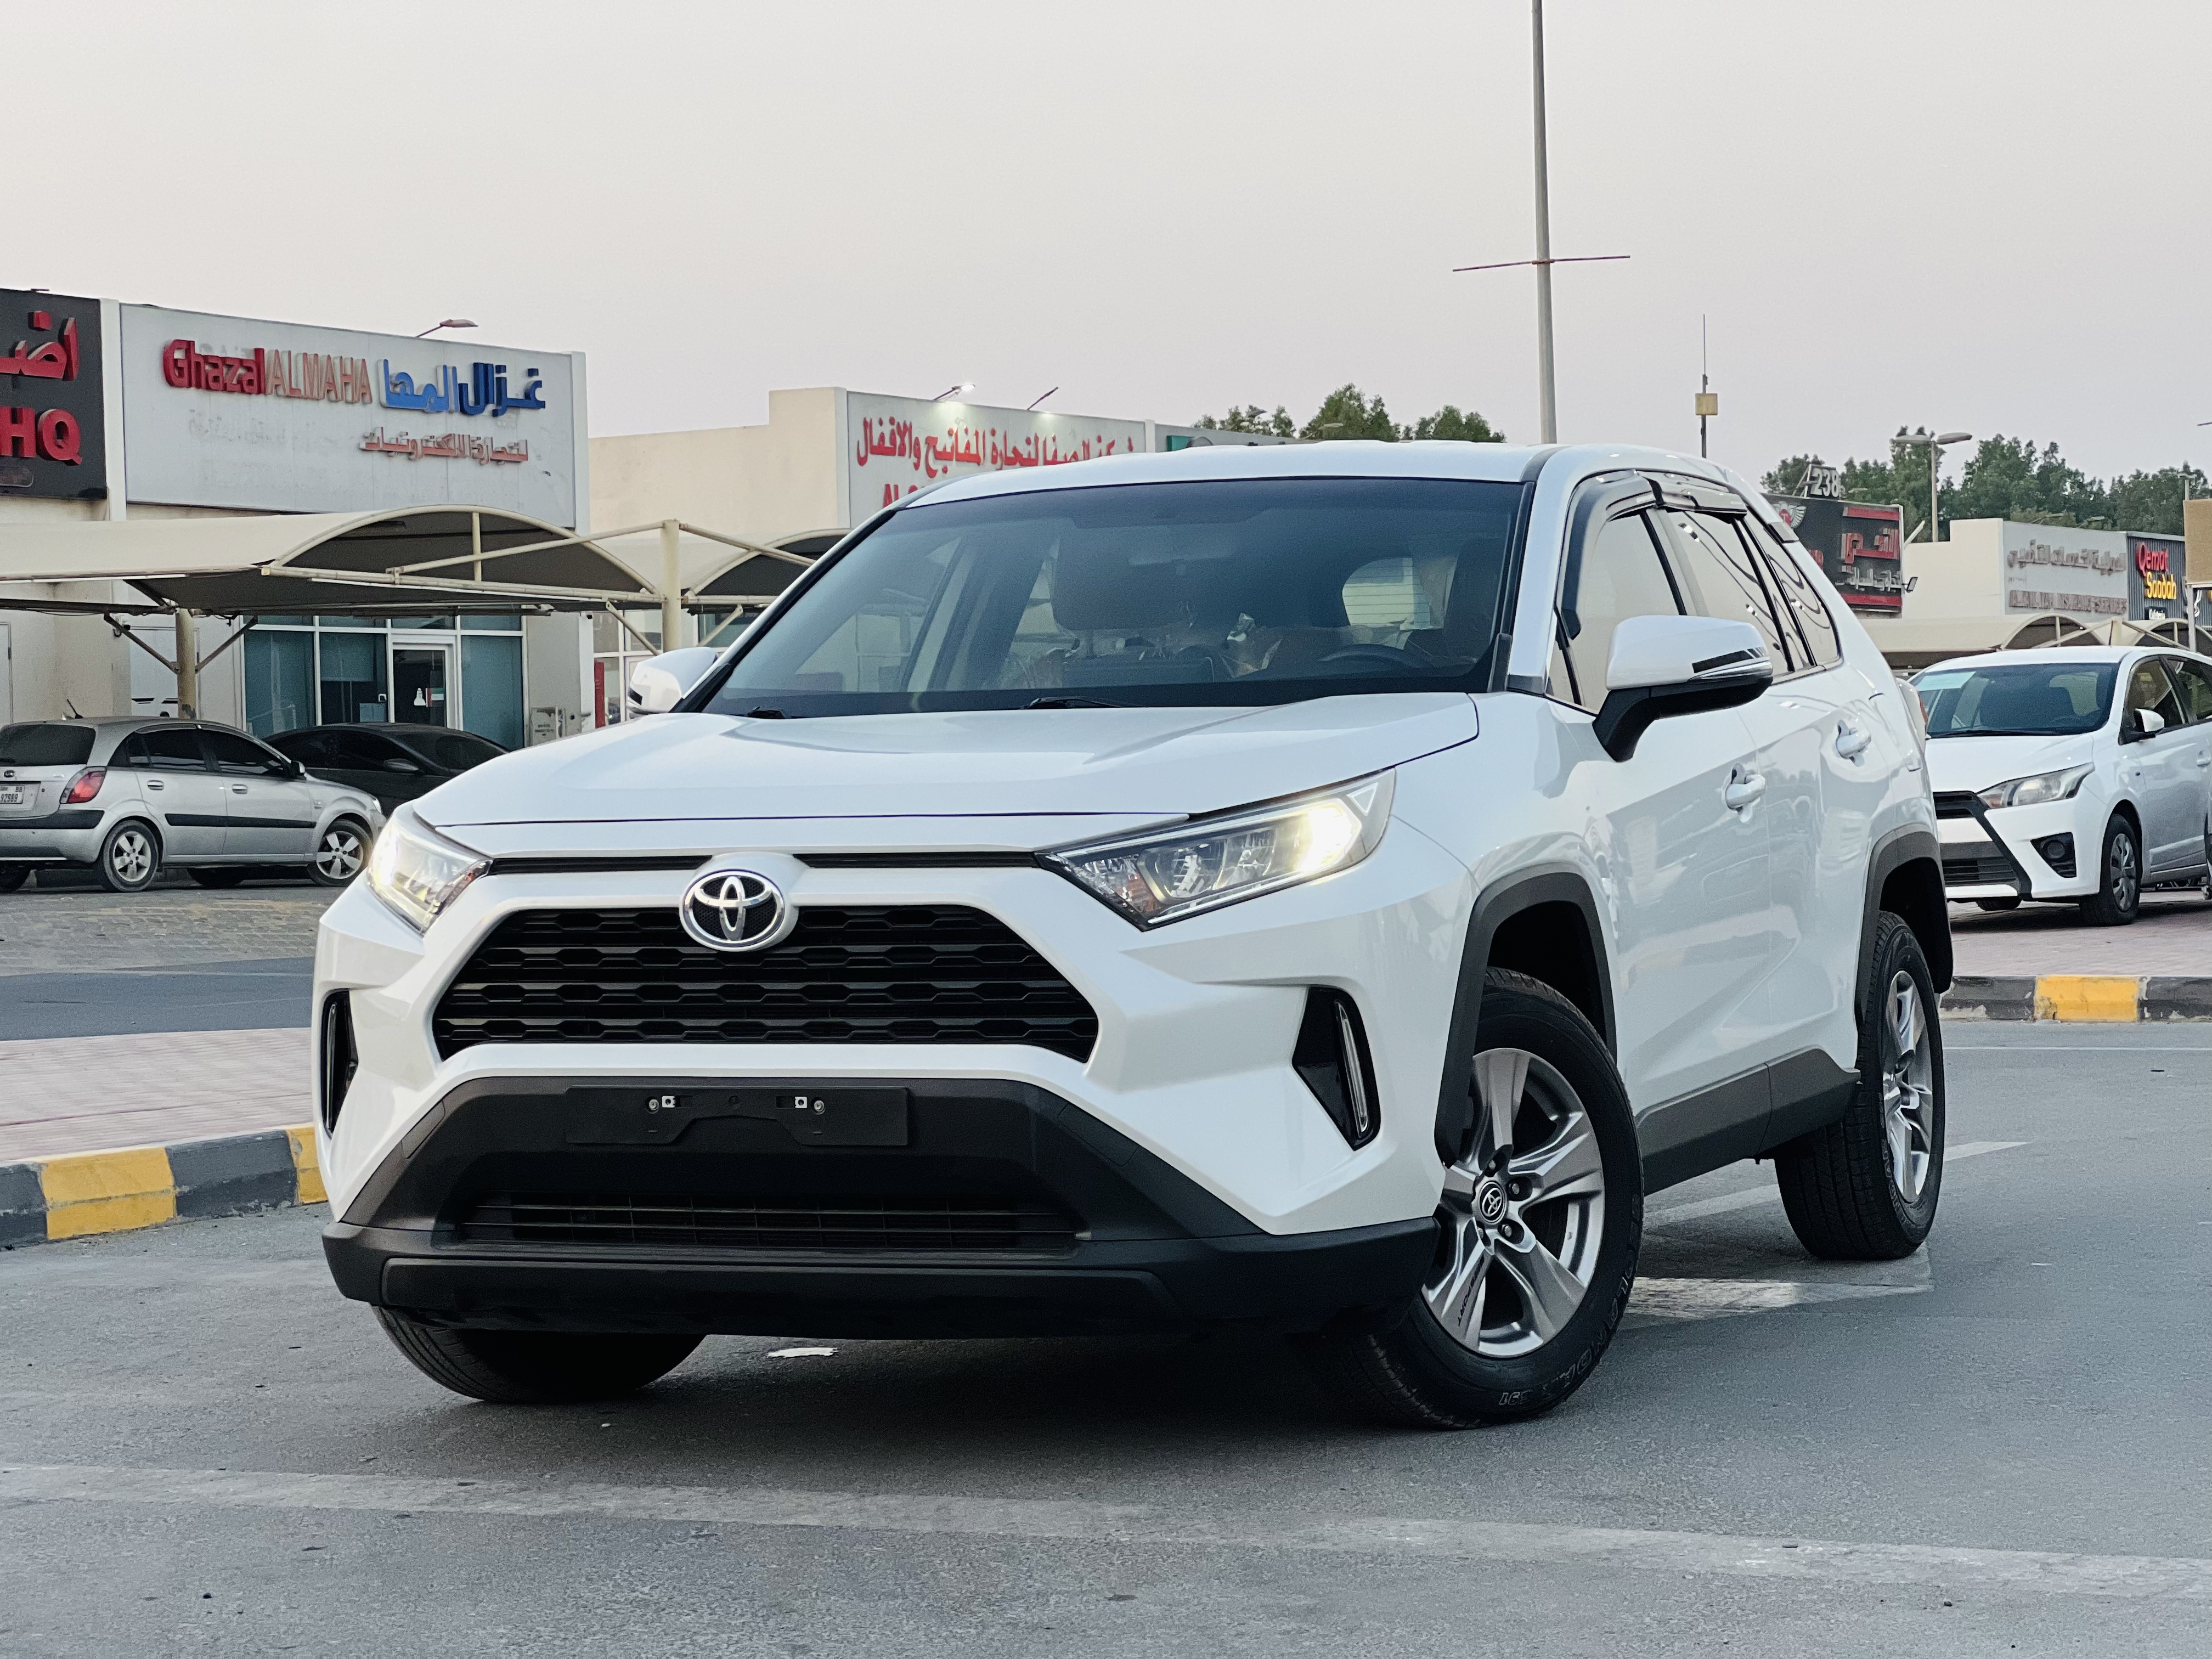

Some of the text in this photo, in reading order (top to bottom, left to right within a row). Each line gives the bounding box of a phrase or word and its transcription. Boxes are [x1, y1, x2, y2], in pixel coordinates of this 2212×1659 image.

[163, 339, 373, 405] Ghazal ALMAHA
[377, 358, 546, 417] غزال المها
[1812, 467, 1839, 498] 238
